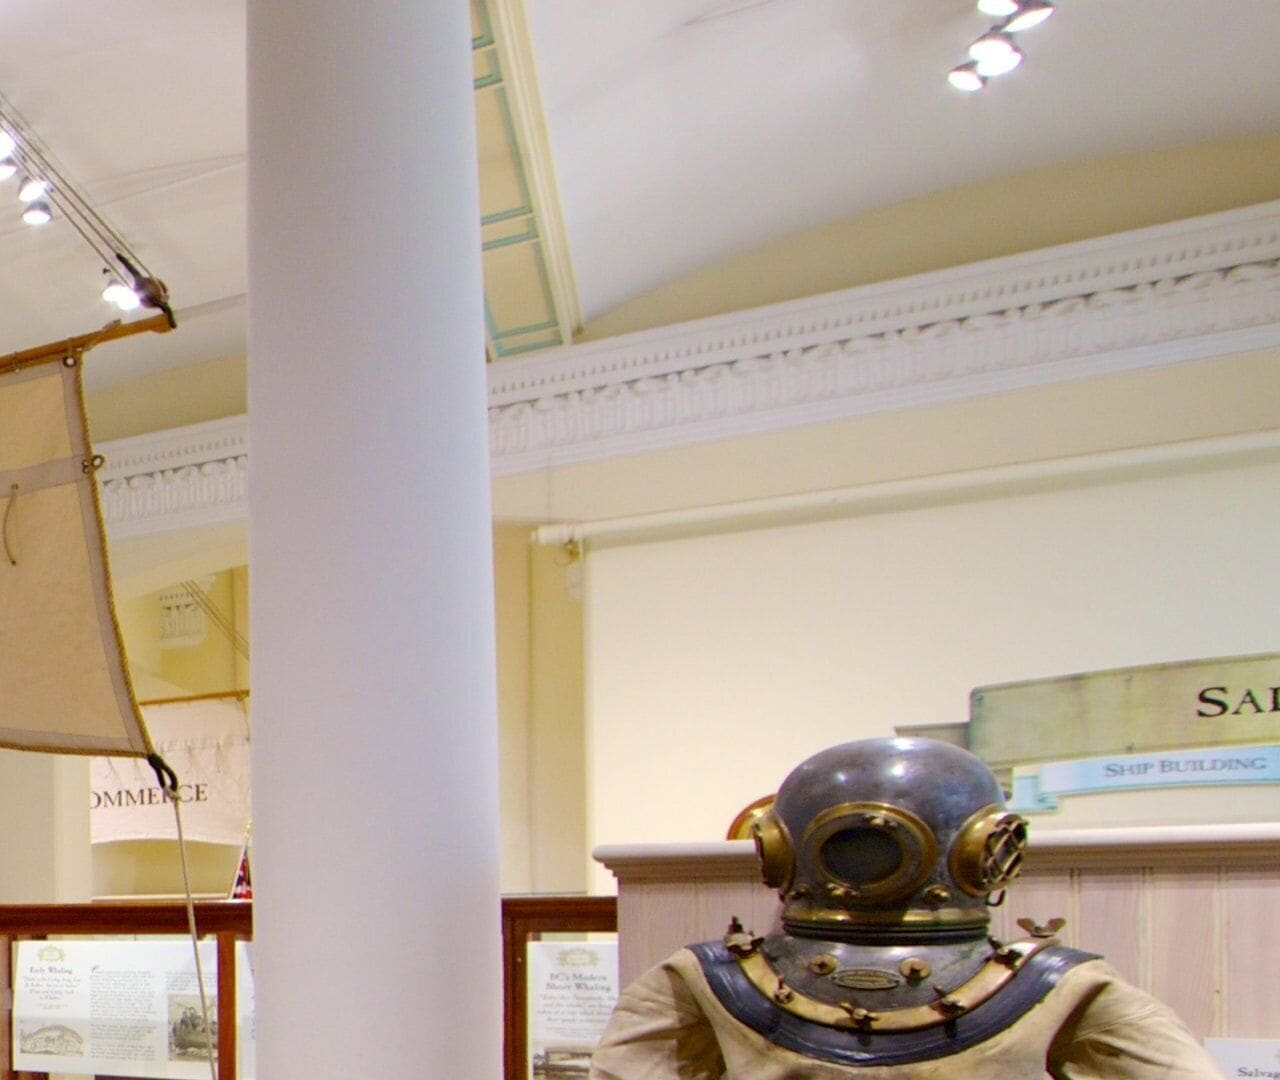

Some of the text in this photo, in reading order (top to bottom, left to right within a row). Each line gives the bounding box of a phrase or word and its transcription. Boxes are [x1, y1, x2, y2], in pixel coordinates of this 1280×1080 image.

[1104, 757, 1268, 777] SHIP BUILDING
[48, 966, 73, 976] Whaling
[575, 982, 611, 992] Whaling
